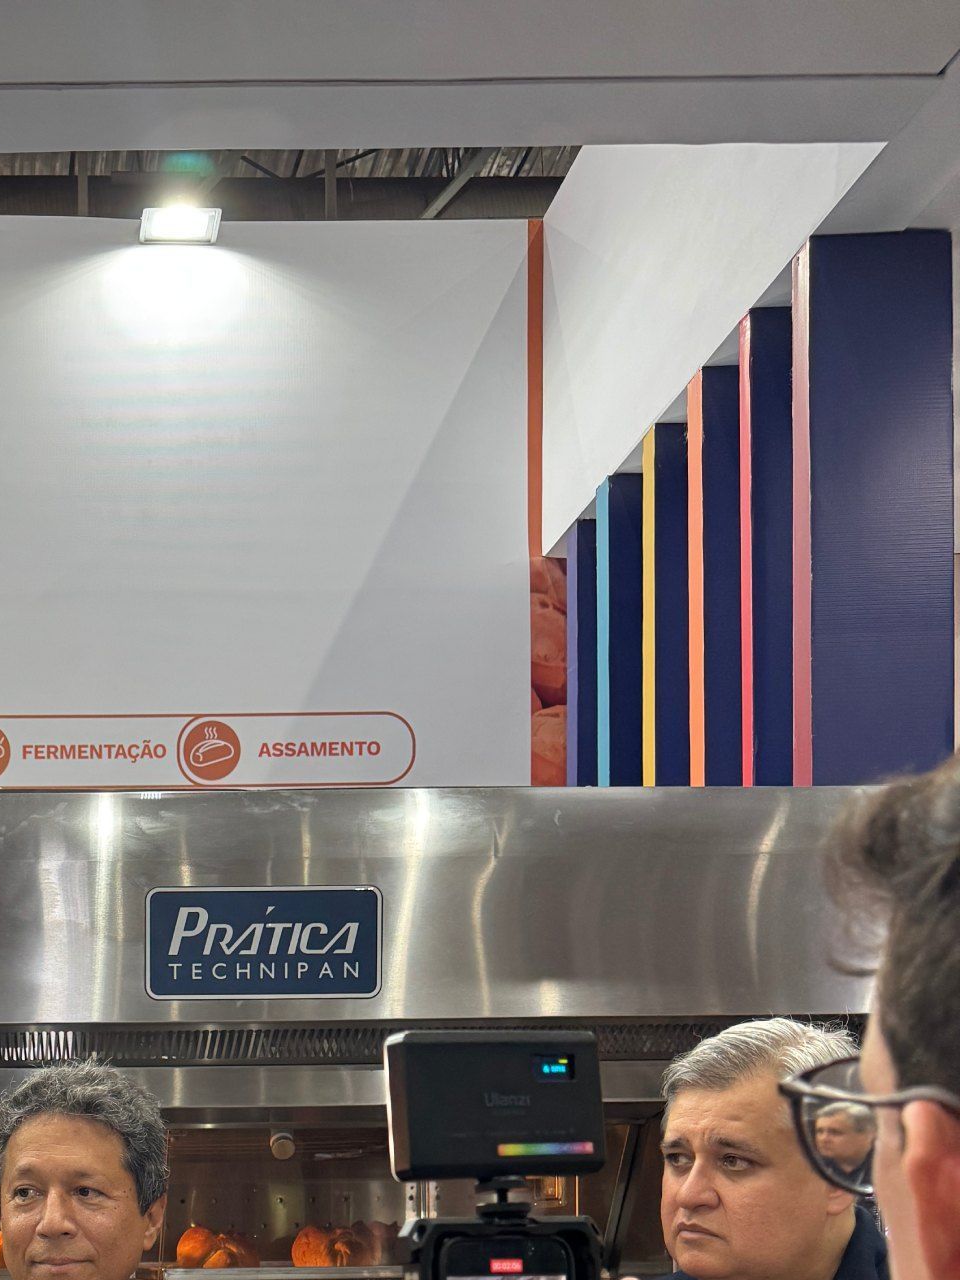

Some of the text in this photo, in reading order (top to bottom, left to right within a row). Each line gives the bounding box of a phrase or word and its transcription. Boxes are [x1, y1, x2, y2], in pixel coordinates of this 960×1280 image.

[22, 739, 167, 763] FERMENTAÇÃO
[258, 741, 381, 758] ASSAMENTO
[168, 961, 360, 980] TECHNIPAN
